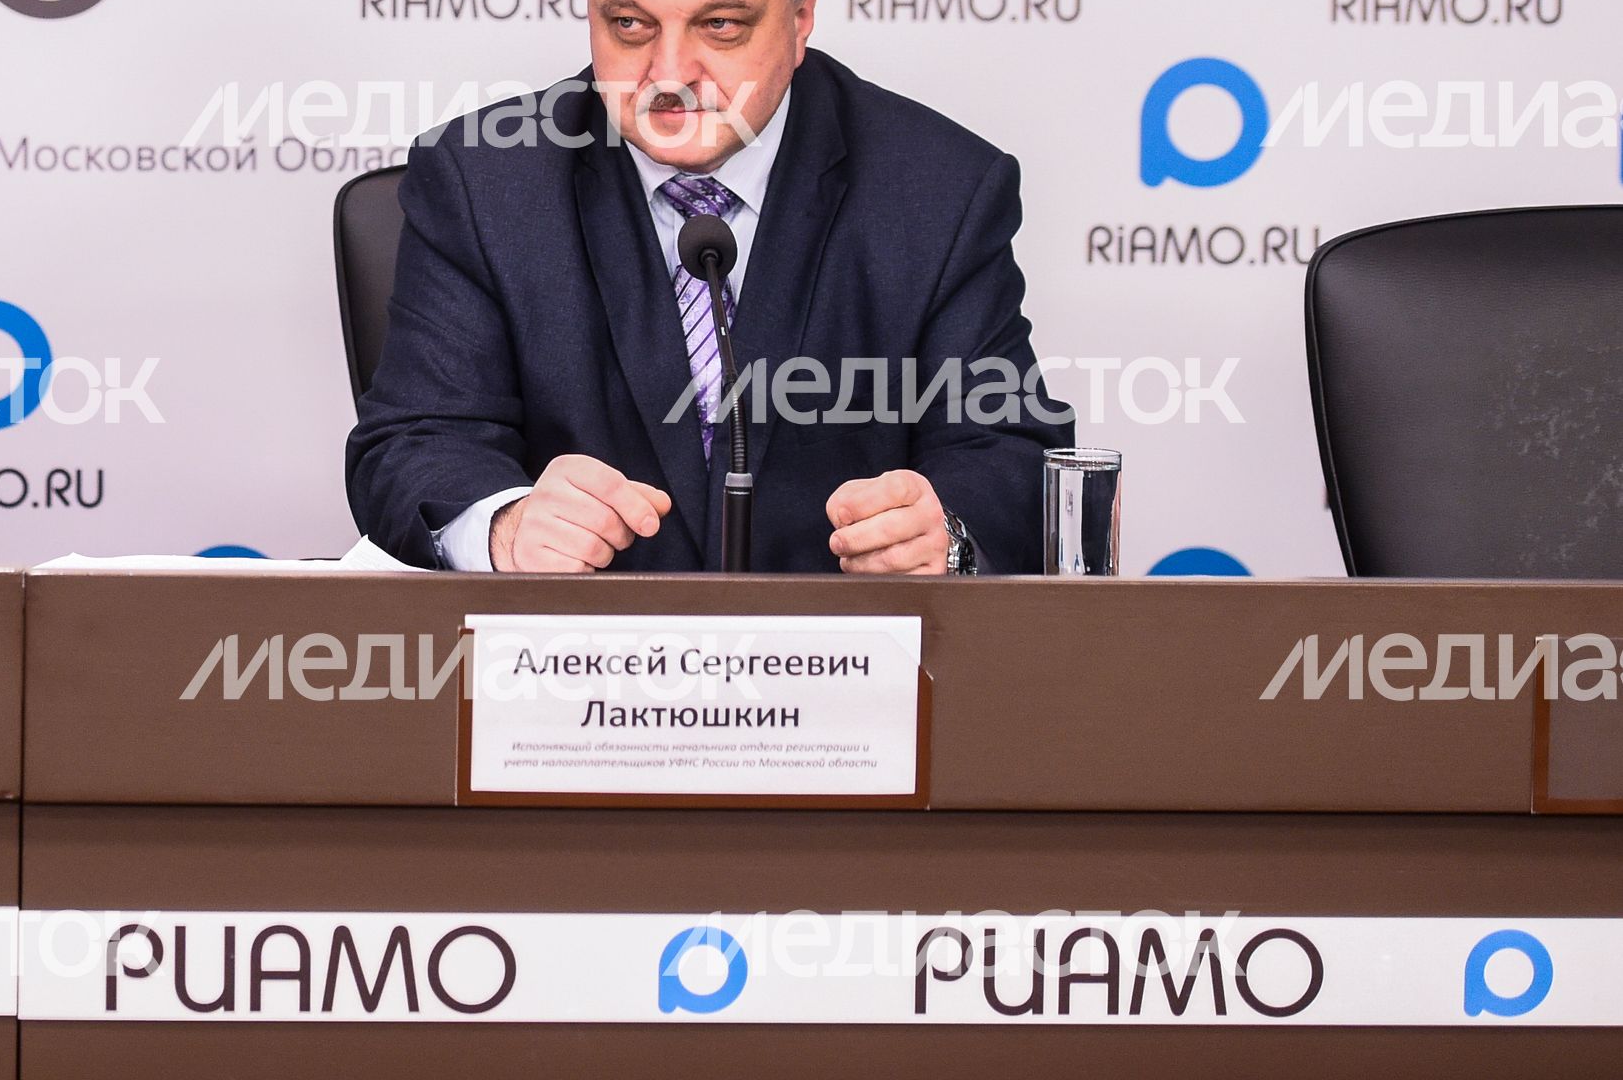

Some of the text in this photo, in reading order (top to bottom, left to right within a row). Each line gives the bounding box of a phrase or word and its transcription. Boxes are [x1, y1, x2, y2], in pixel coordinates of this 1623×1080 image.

[514, 647, 869, 682] Алексей Сергеевич
[581, 701, 799, 727] Лактюшкин
[511, 741, 592, 754] Исполняющий
[594, 741, 669, 753] обязанности
[672, 743, 736, 753] начальника
[740, 742, 783, 753] отдела
[785, 743, 860, 755] регистрации
[668, 758, 699, 769] УФНС
[702, 758, 740, 769] России
[758, 757, 826, 769] Московской
[828, 758, 878, 769] области
[105, 924, 517, 1015] РИАМО
[914, 928, 1325, 1018] РИАМО
